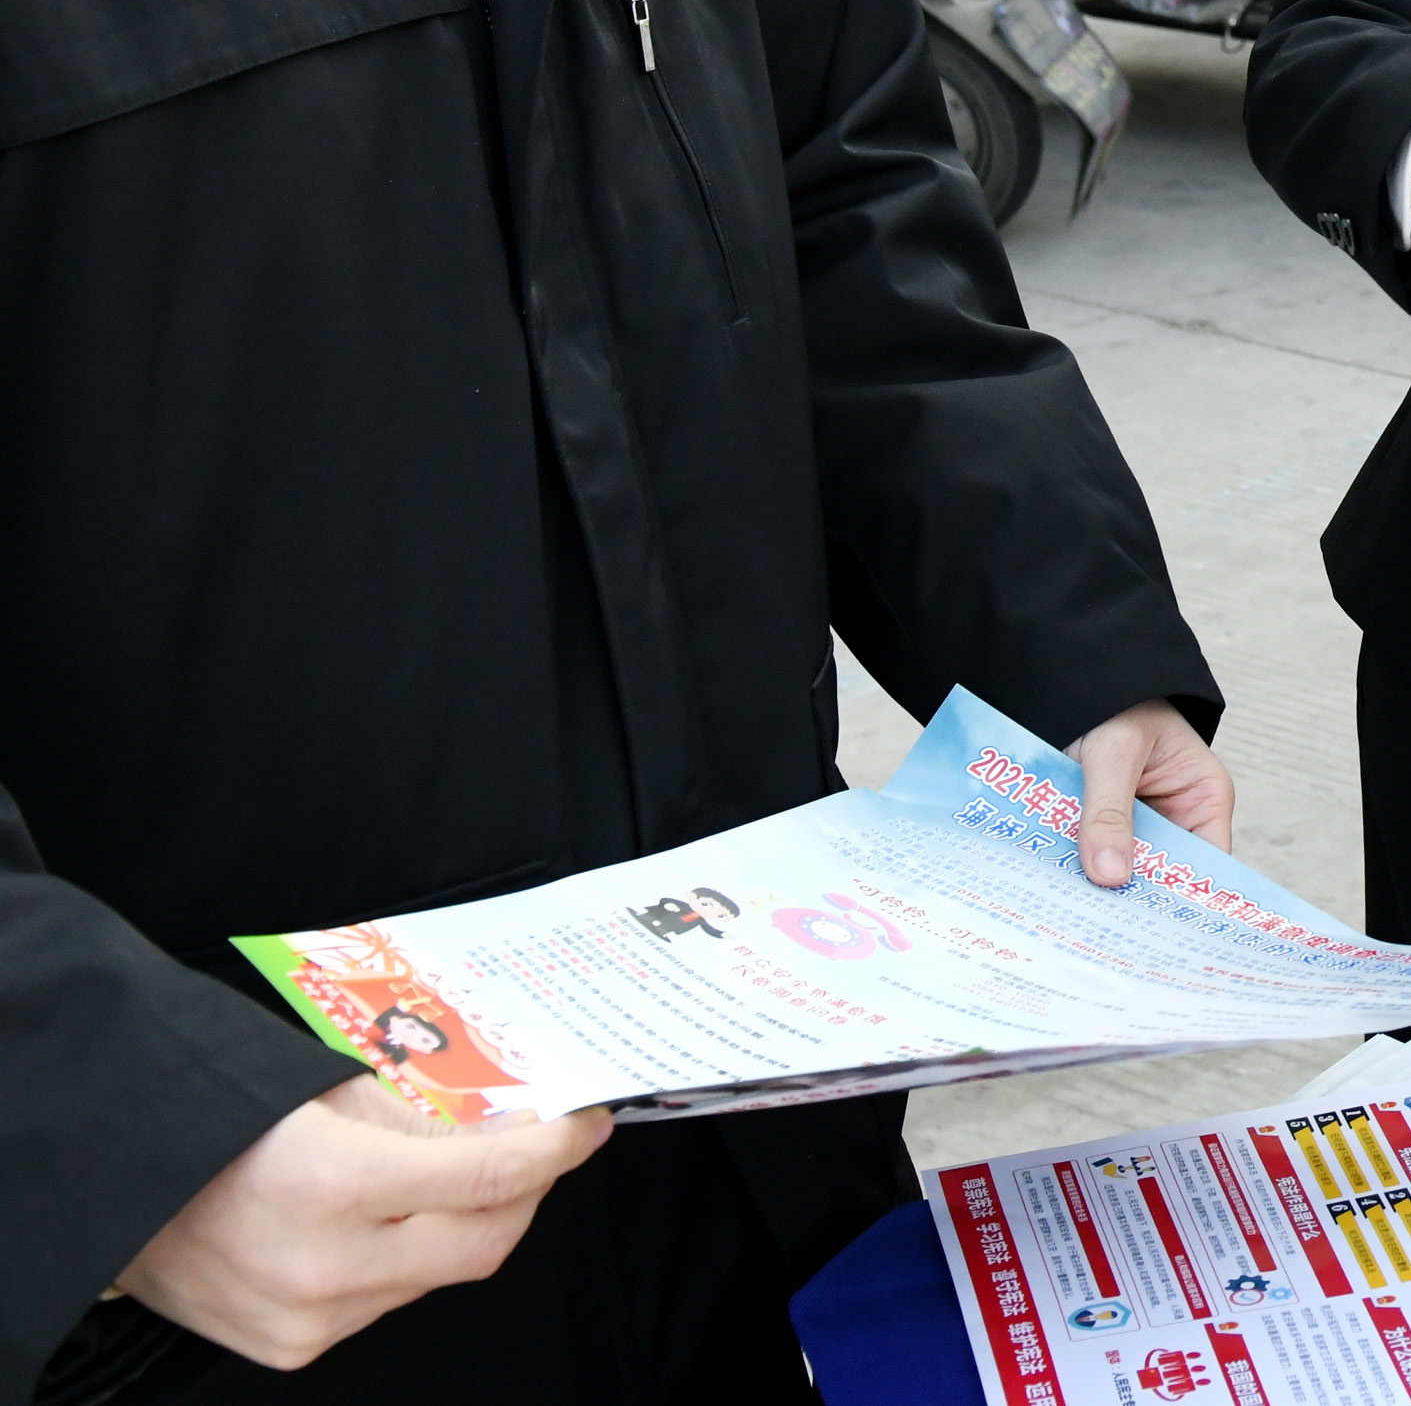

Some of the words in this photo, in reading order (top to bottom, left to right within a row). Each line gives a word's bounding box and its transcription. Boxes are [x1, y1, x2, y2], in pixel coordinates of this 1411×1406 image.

[731, 964, 848, 1026] 民意调查问卷
[734, 945, 888, 1026] 群众安全感满意度
[960, 1176, 996, 1219] 尊崇宪法
[1274, 1175, 1322, 1241] 宪法作用是什么
[974, 1220, 1011, 1266] 学习宪法
[988, 1267, 1028, 1318] 遵守宪法
[1004, 1320, 1046, 1377] 维护宪法
